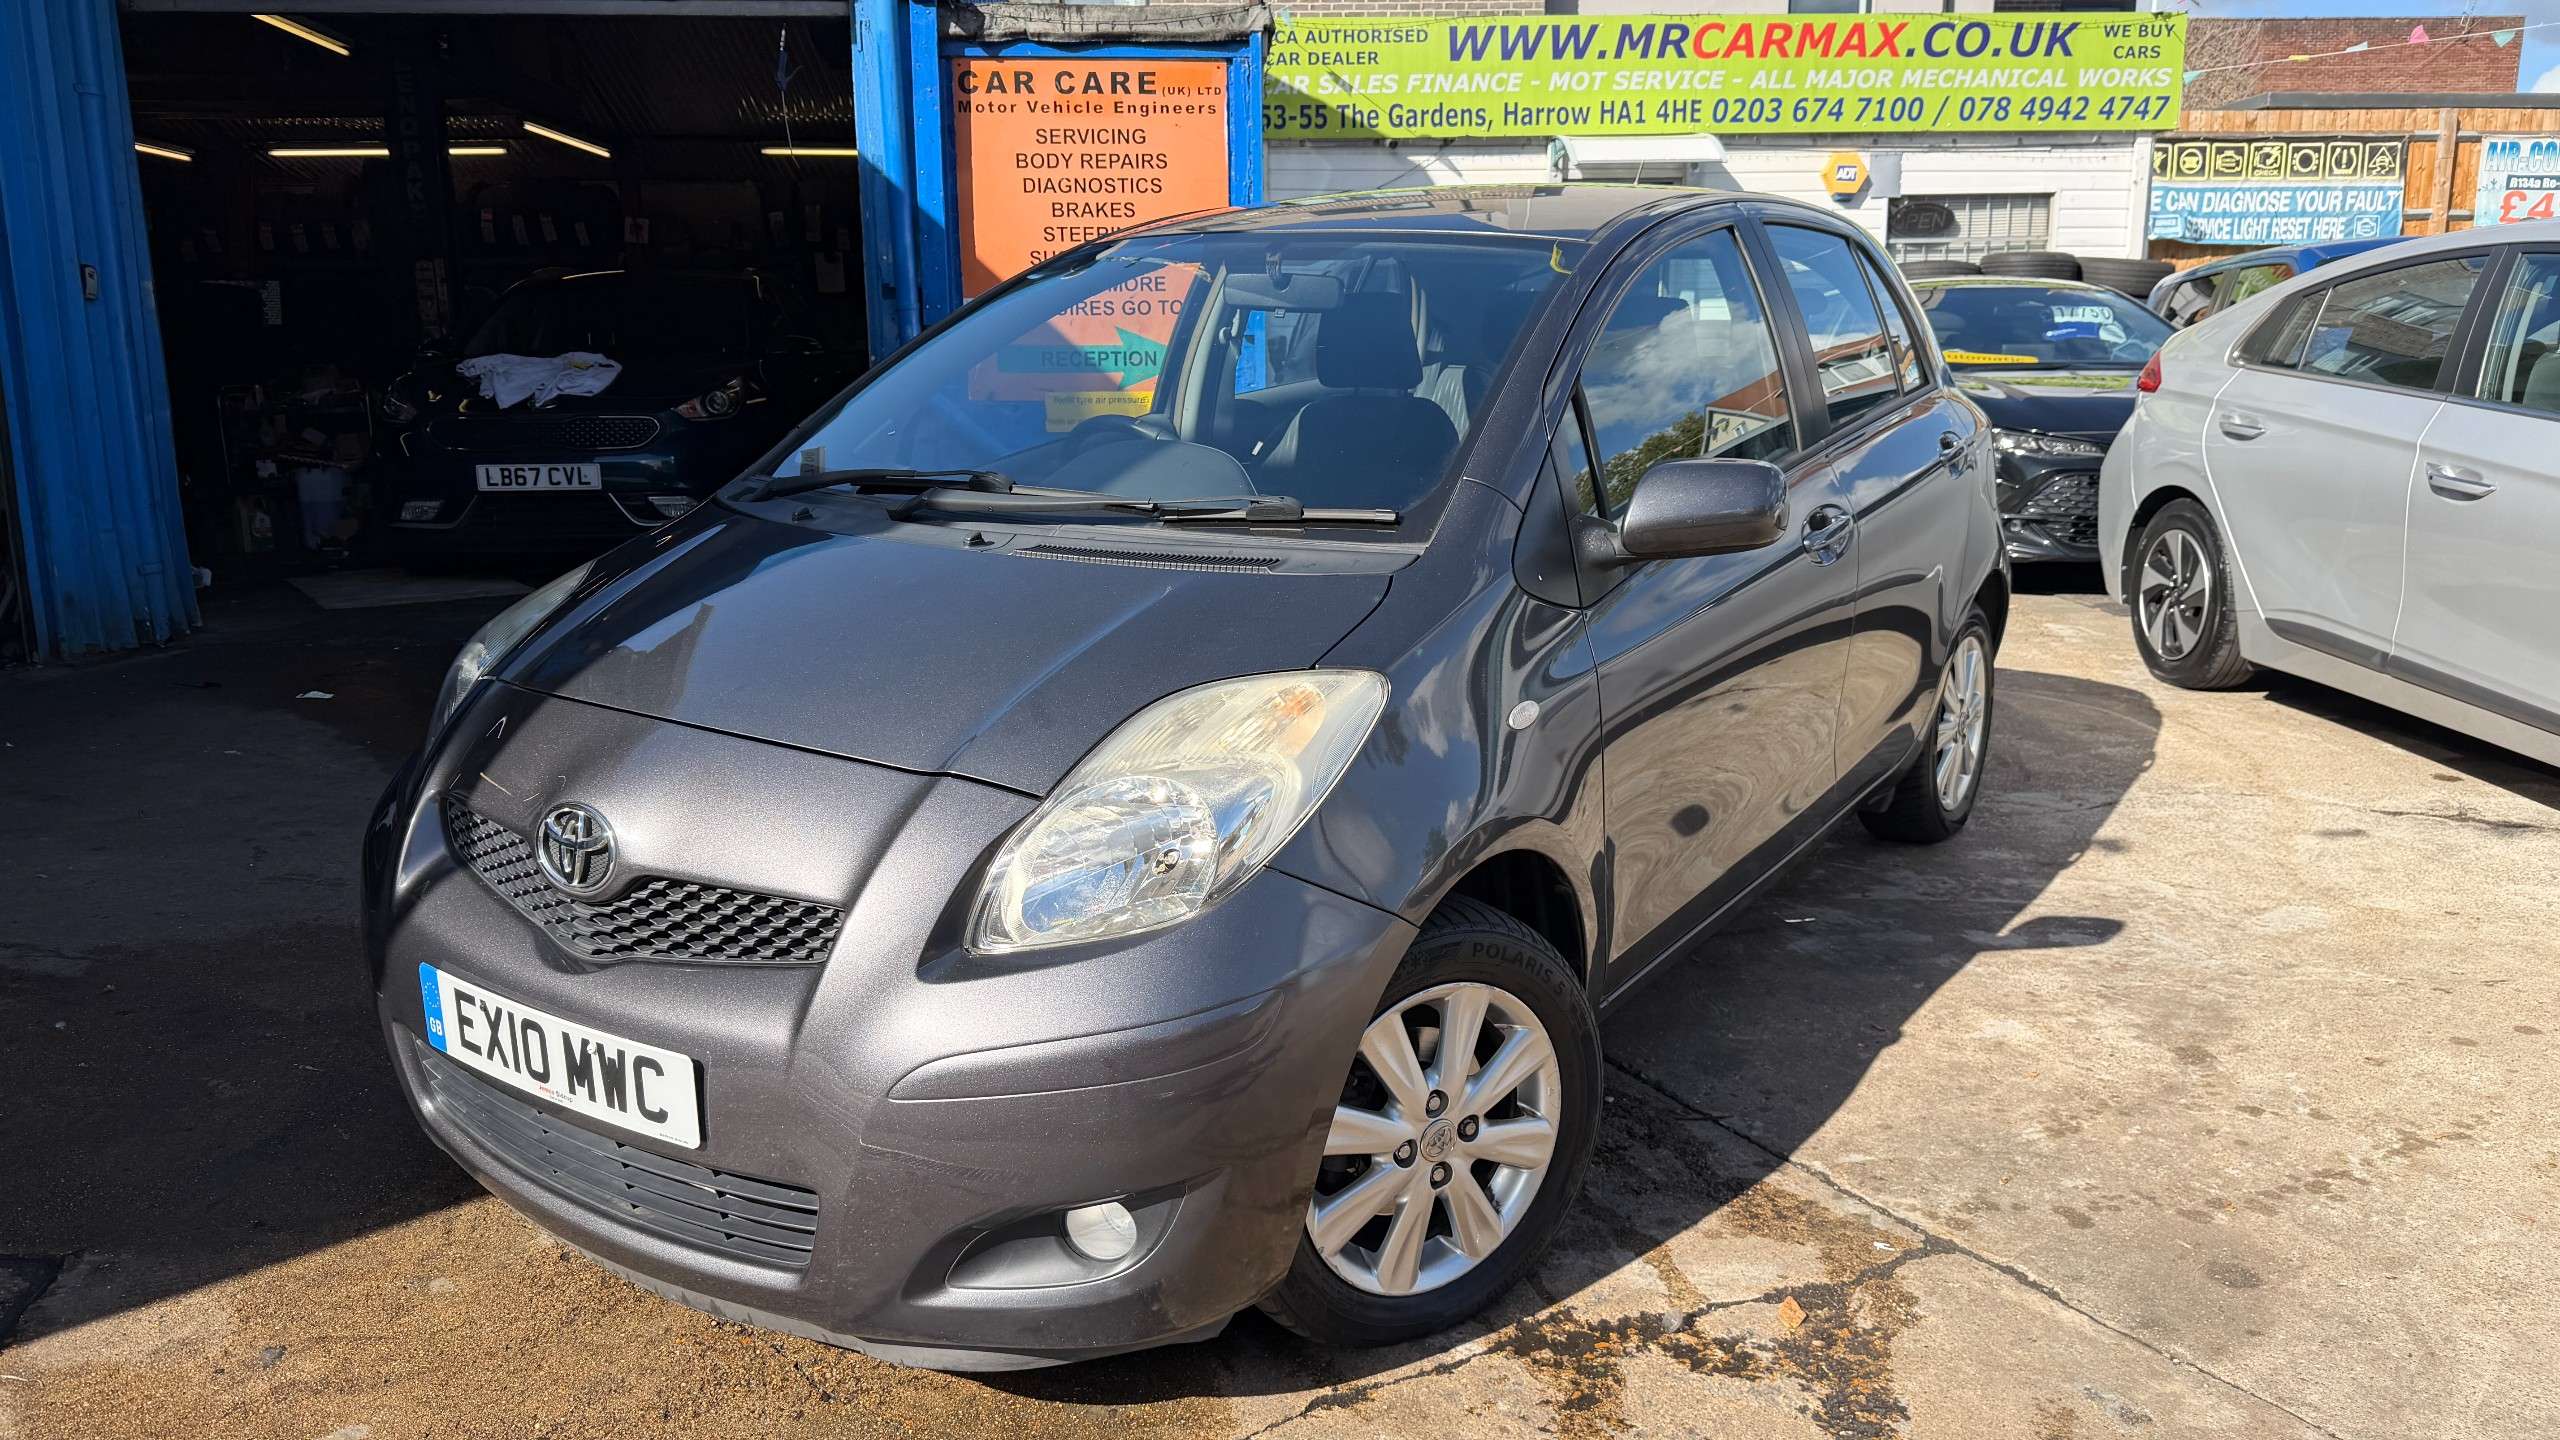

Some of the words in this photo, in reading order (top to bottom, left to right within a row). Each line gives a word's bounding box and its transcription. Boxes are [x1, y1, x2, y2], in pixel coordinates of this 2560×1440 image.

[1275, 29, 1298, 44] CA
[1305, 28, 1429, 44] AUTHORISED
[2104, 24, 2132, 38] WE
[2138, 24, 2176, 38] BUY
[1449, 21, 2081, 62] WWW.MRCARMAX.CO.UK
[1266, 51, 1300, 66] CAR
[1308, 51, 1380, 66] DEALER
[2113, 45, 2161, 59] CARS
[957, 70, 1036, 95] CAR
[1054, 70, 1157, 95] CARE
[1161, 86, 1191, 97] (UK)
[1197, 86, 1222, 96] LTD
[1268, 74, 1311, 96] AR
[1317, 73, 1399, 95] SALES
[1405, 72, 1523, 94] FINANCE
[1549, 71, 1608, 92] MOT
[1612, 70, 1726, 91] SERVICE
[1750, 69, 1796, 89] ALL
[1804, 69, 1893, 89] MAJOR
[1899, 68, 2068, 88] MECHANICAL
[2078, 67, 2173, 88] WORKS
[957, 100, 1018, 114] Motor
[1026, 100, 1104, 114] Vehicle
[1113, 100, 1217, 117] Engineers
[1263, 104, 1328, 129] 53-55
[1336, 104, 1380, 129] The
[1388, 102, 1494, 132] Gardens,
[1503, 101, 1592, 127] Harrow
[1599, 100, 1646, 125] HA1
[1656, 99, 1702, 124] 4HE
[1711, 97, 1783, 124] 0203
[1792, 97, 1844, 123] 674
[1854, 96, 1924, 122] 7100
[1958, 96, 2012, 122] 078
[2019, 96, 2090, 121] 4942
[2098, 96, 2170, 121] 4747
[1035, 128, 1147, 145] SERVICING
[1015, 152, 1074, 170] BODY
[1080, 152, 1168, 170] REPAIRS
[2485, 141, 2560, 172] AIR-CO
[1835, 165, 1857, 181] ADT
[1023, 177, 1162, 194] DIAGNOSTICS
[1051, 201, 1136, 218] BRAKES
[2150, 190, 2164, 212] E
[2166, 190, 2200, 212] CAN
[2202, 190, 2293, 213] DIAGNOSE
[2296, 190, 2347, 213] YOUR
[2498, 190, 2560, 224] £4
[2186, 215, 2231, 240] SERVICE
[2232, 216, 2271, 240] LIGHT
[2272, 217, 2313, 240] RESET
[2312, 217, 2348, 240] HERE
[1122, 300, 1151, 316] GO
[1157, 300, 1184, 315] TO
[1041, 350, 1157, 367] RECEPTION
[485, 467, 540, 488] LB67
[548, 466, 592, 487] CVL
[1472, 942, 1554, 983] POLARIS
[429, 1016, 443, 1037] GB
[453, 987, 551, 1085] EX10
[561, 1031, 669, 1124] MWC
